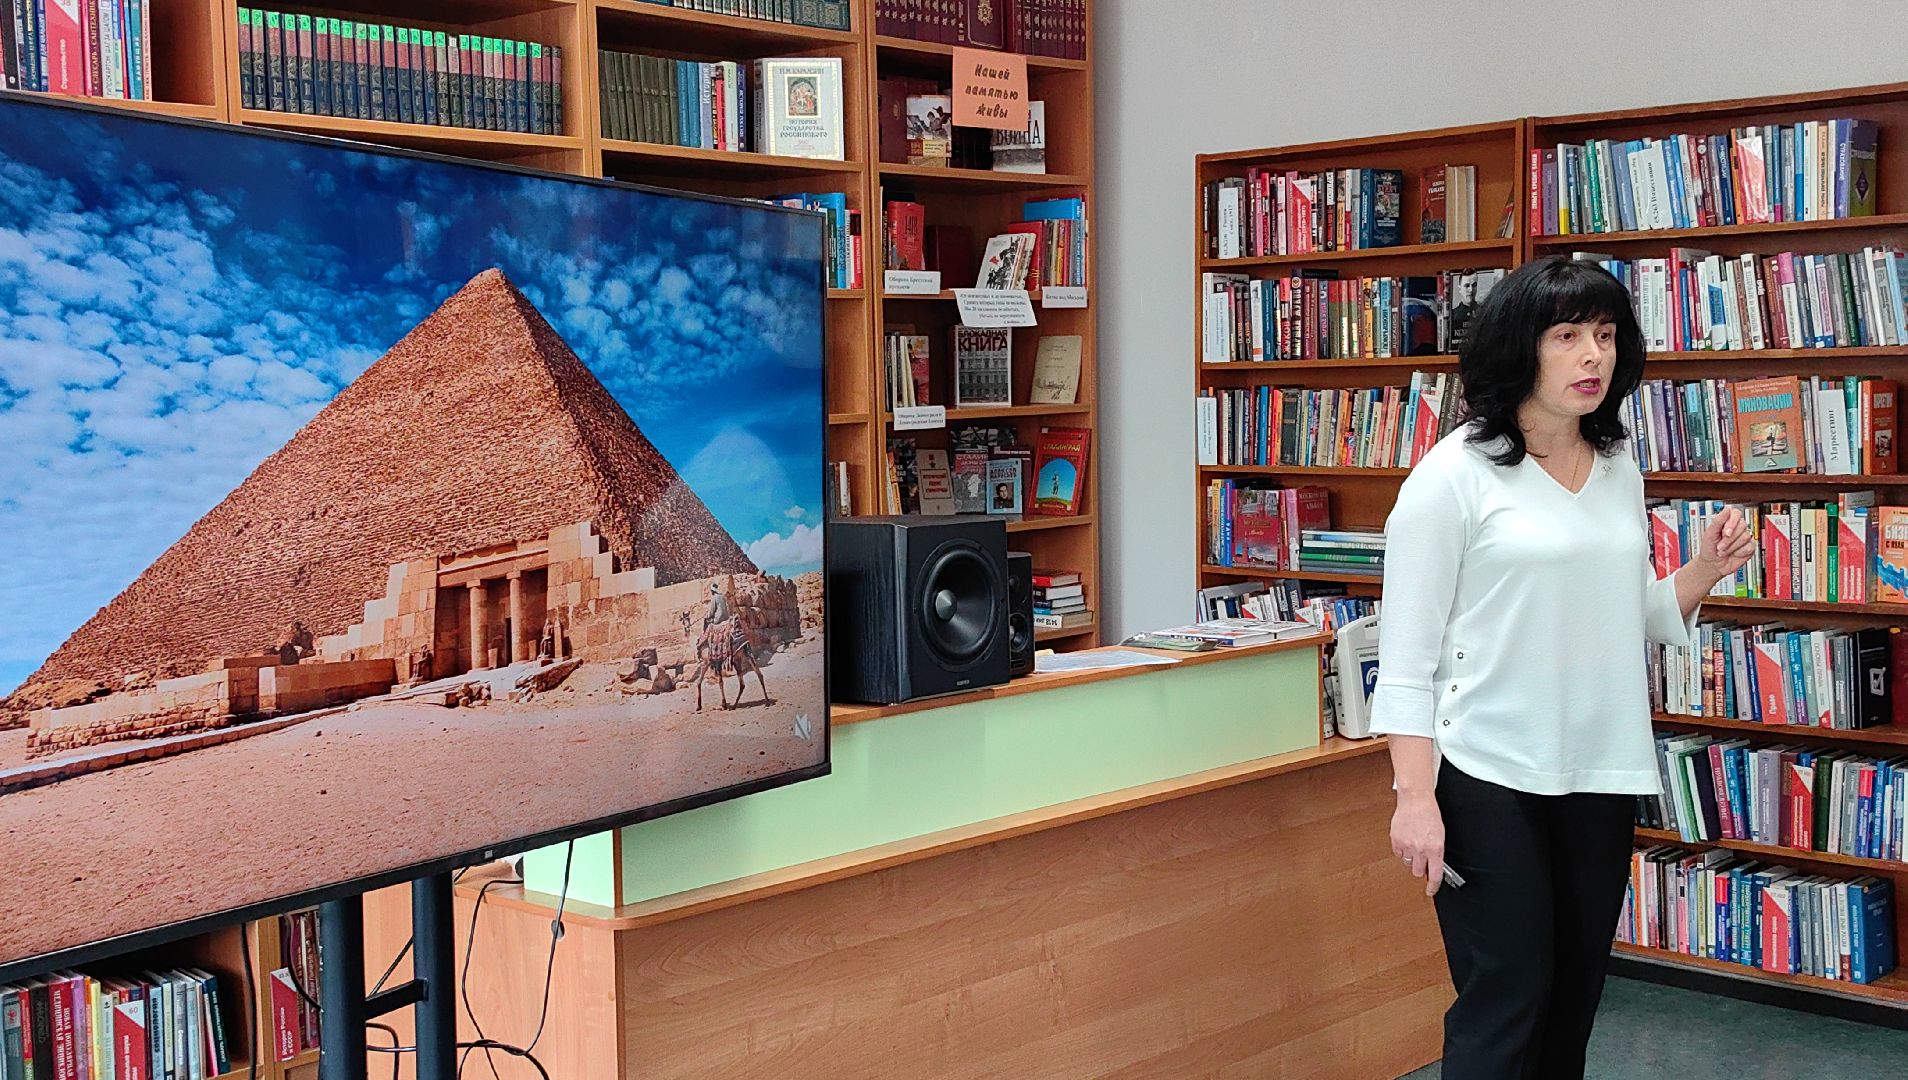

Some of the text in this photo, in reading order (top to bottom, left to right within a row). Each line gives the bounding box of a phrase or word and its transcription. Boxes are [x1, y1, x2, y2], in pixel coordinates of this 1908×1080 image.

[60, 38, 68, 90] Строительство
[975, 64, 1010, 80] Нашей
[700, 68, 711, 104] История
[965, 85, 1018, 100] памятью
[976, 104, 1008, 118] живы
[960, 337, 1008, 351] КНИГА
[1739, 393, 1793, 413] ИННОВАЦИИ
[1828, 410, 1839, 461] Маркетинг
[1791, 540, 1800, 567] МИРОВОЙ
[1792, 568, 1800, 594] ИСТОРИЯ
[54, 990, 64, 1041] МЕДИЦИНСКАЯ
[65, 1032, 74, 1078] ПОПУЛЯРНАЯ
